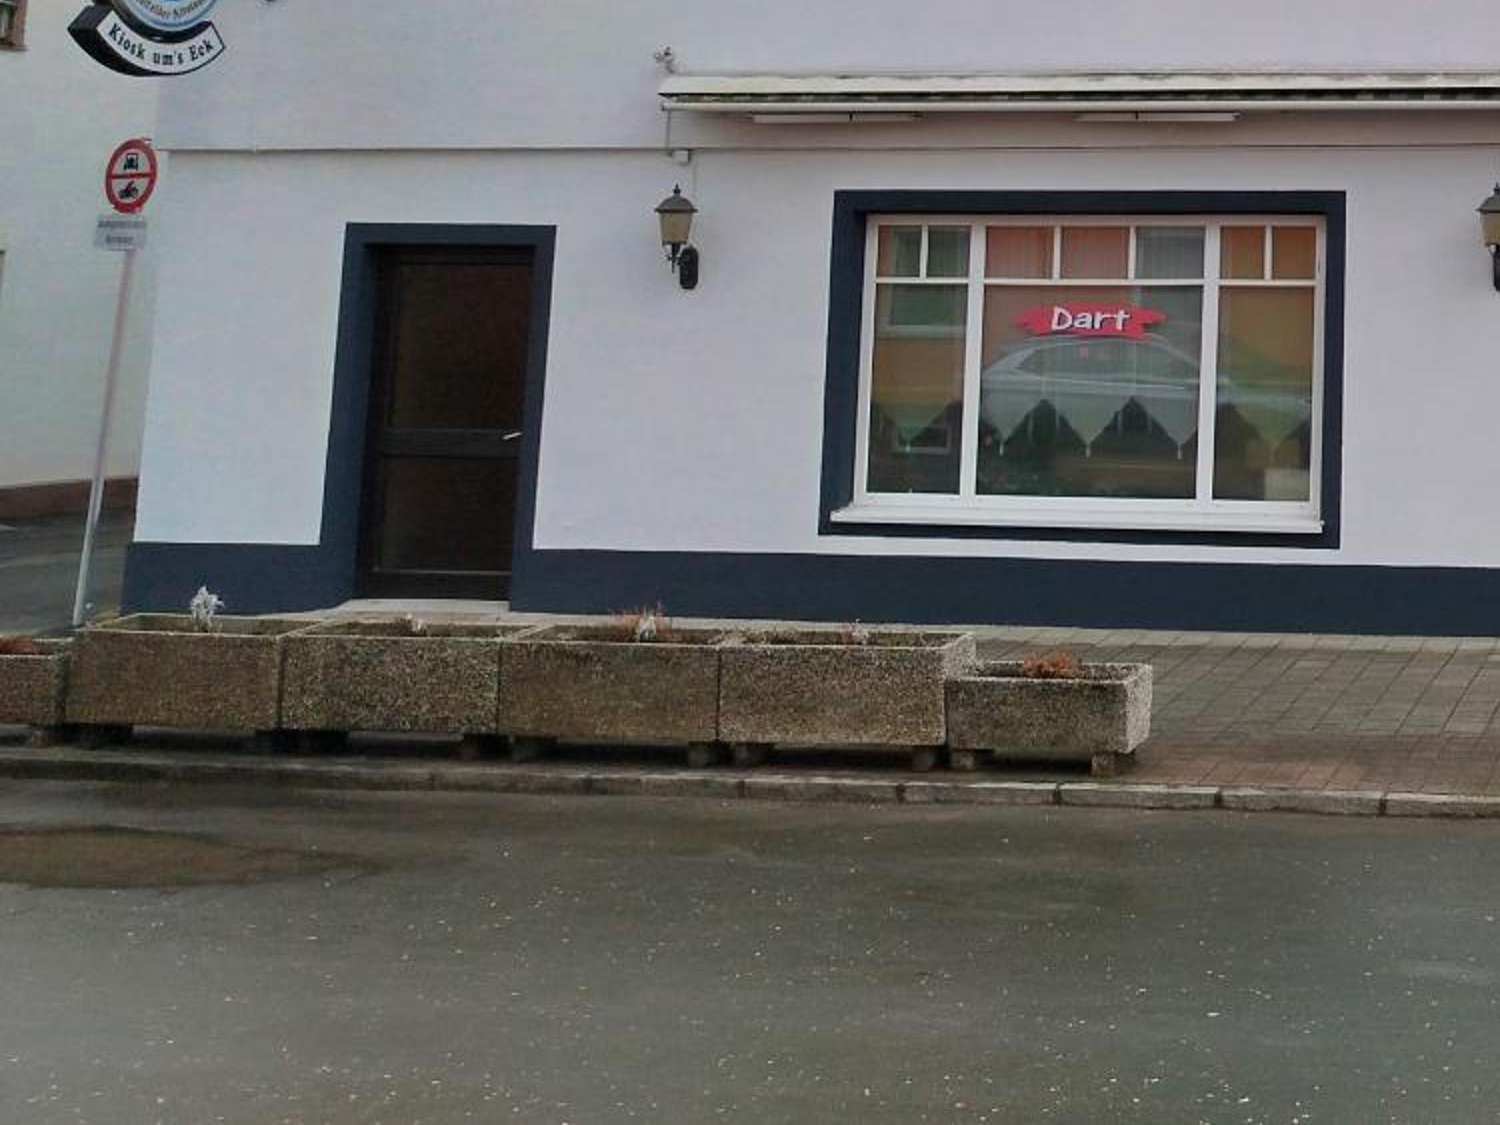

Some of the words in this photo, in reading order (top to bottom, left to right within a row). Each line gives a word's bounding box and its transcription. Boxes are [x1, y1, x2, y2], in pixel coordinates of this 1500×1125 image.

[108, 22, 146, 60] Kiosk
[153, 50, 184, 66] um's
[188, 38, 214, 62] Eck
[1051, 306, 1131, 332] Dart
